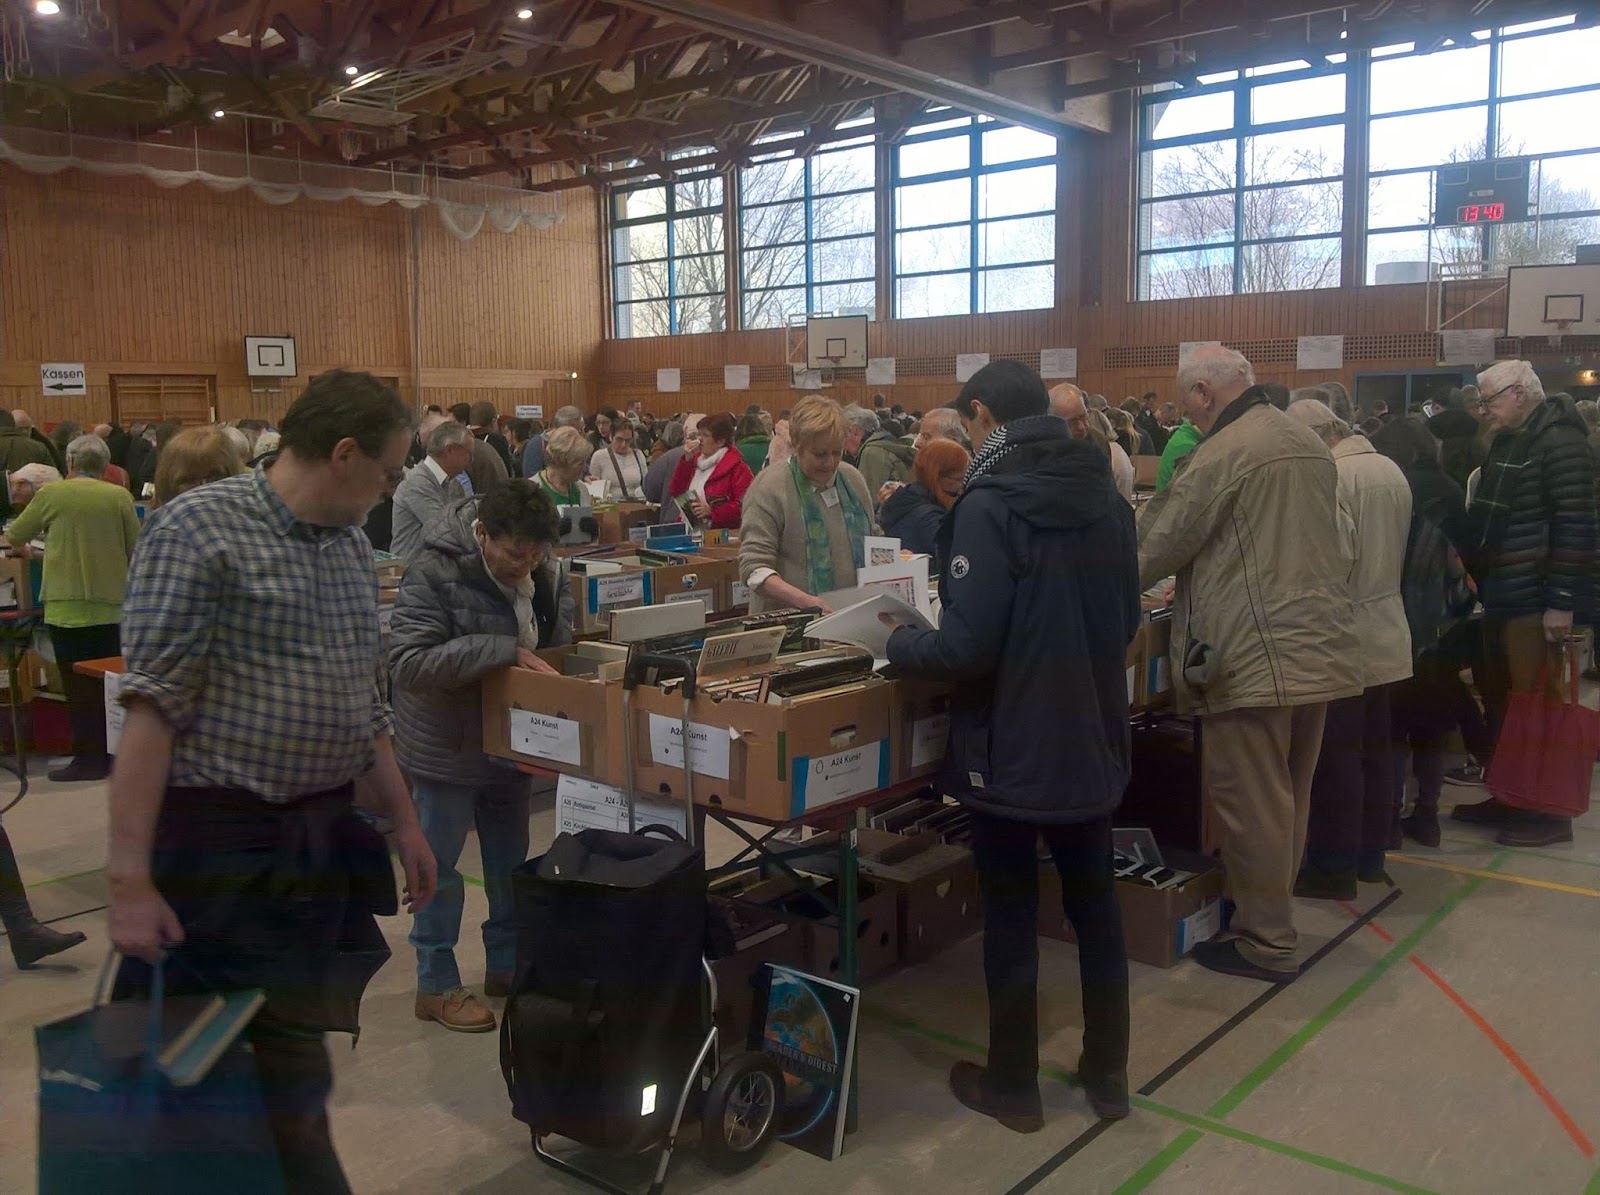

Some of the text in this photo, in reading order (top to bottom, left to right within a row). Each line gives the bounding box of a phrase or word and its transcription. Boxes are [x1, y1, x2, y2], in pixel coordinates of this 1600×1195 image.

[42, 368, 84, 379] Kassen
[530, 716, 559, 730] A24 Kunst
[831, 752, 862, 768] A24 Kunst
[808, 1055, 838, 1074] DIGEST
